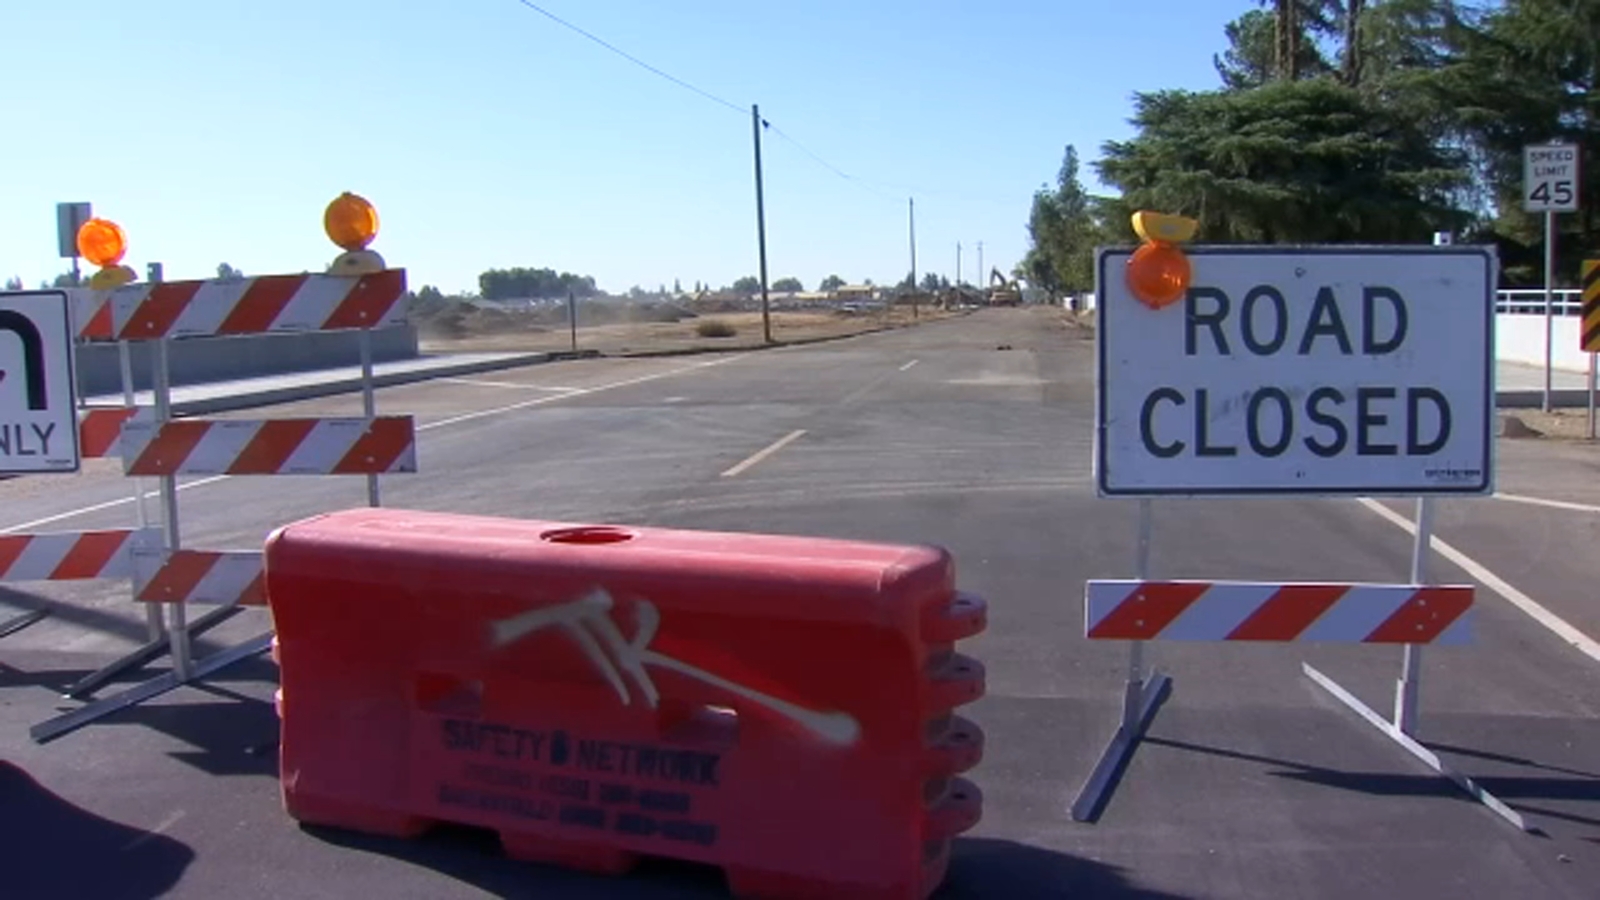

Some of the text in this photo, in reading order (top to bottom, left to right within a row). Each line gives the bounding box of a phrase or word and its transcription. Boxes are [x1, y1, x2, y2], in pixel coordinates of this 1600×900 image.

[1530, 150, 1573, 163] SPEED
[1534, 165, 1568, 177] LIMIT
[1529, 181, 1573, 205] 45
[1184, 285, 1409, 356] ROAD
[1140, 387, 1452, 458] CLOSED
[443, 719, 547, 761] SAFETY
